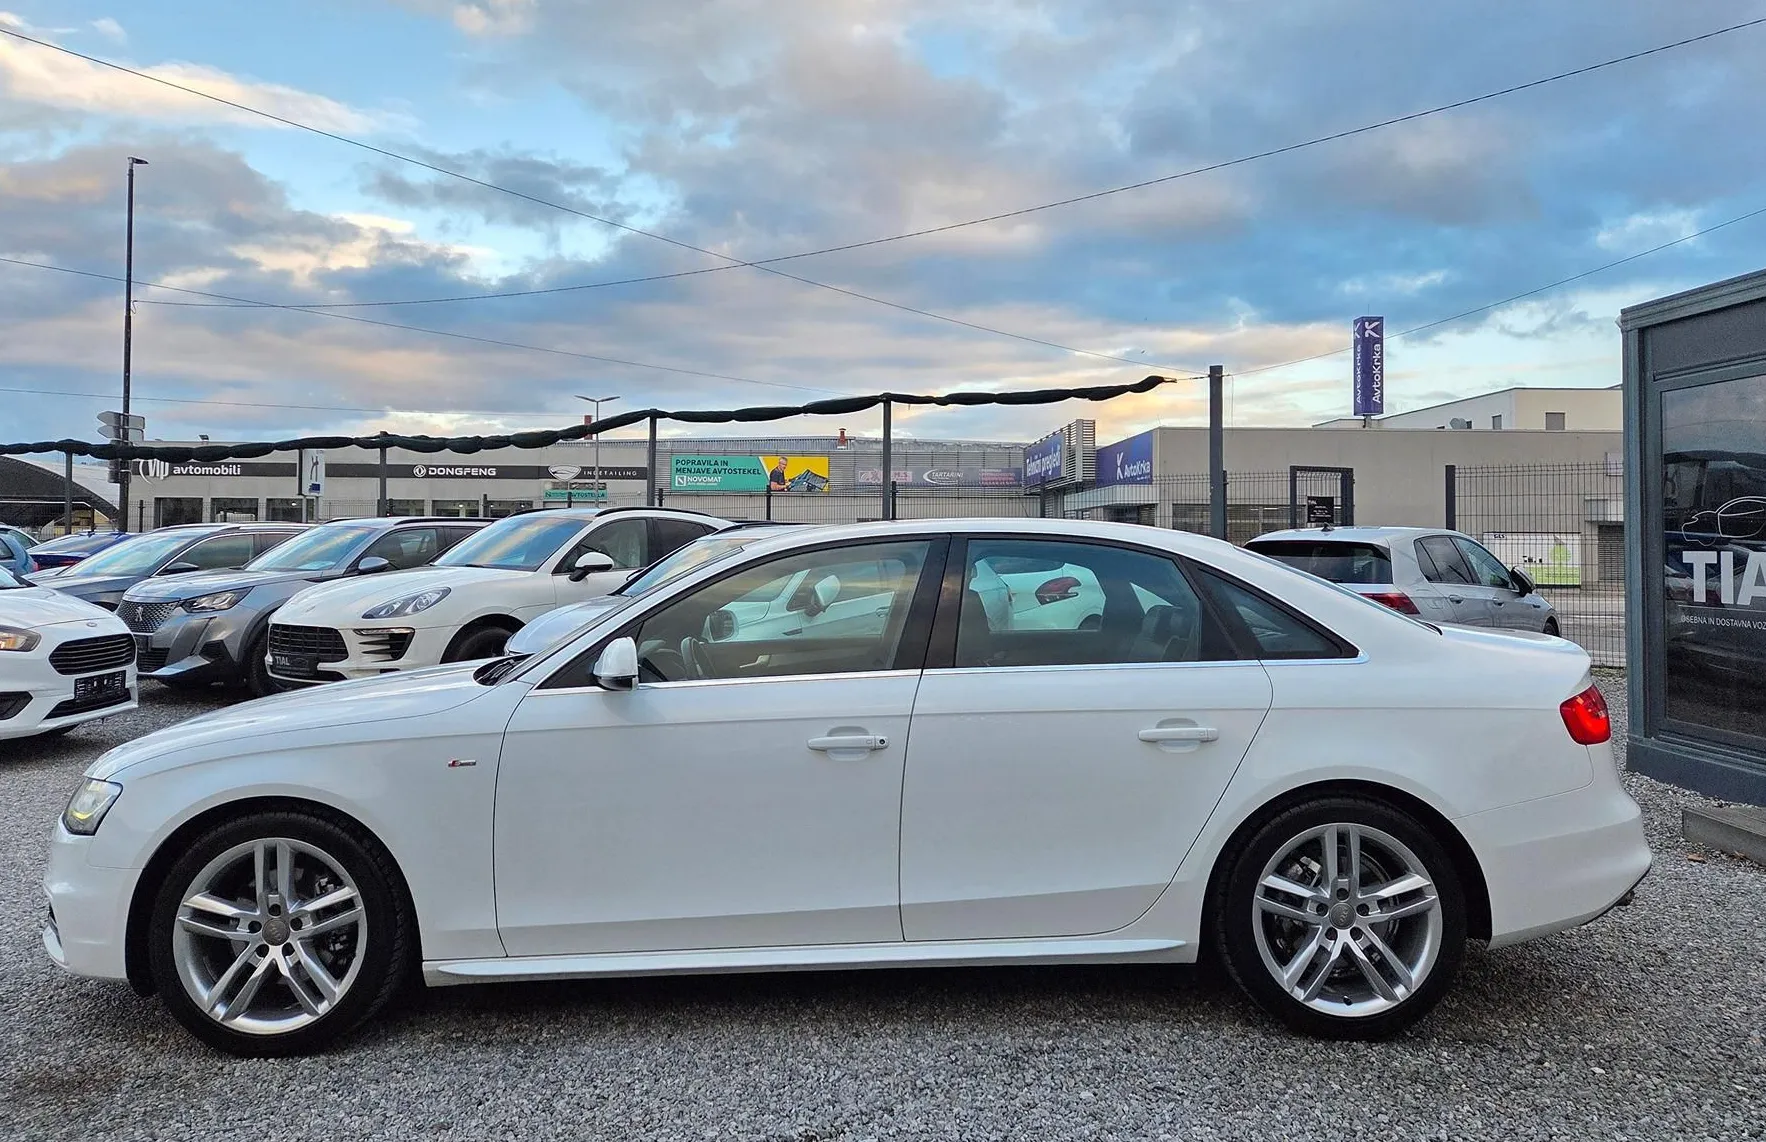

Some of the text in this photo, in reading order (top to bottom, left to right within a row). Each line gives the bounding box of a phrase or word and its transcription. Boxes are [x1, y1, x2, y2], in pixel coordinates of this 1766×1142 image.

[1372, 343, 1381, 404] AvtoKrka
[173, 465, 241, 475] avtomobili
[428, 467, 497, 476] DONGFENG
[675, 467, 712, 475] MENJAVE
[1124, 460, 1151, 478] AvtoKrka
[1681, 615, 1707, 624] OSEBNA
[1708, 617, 1715, 626] IN
[1716, 618, 1752, 628] DOSTAVNA
